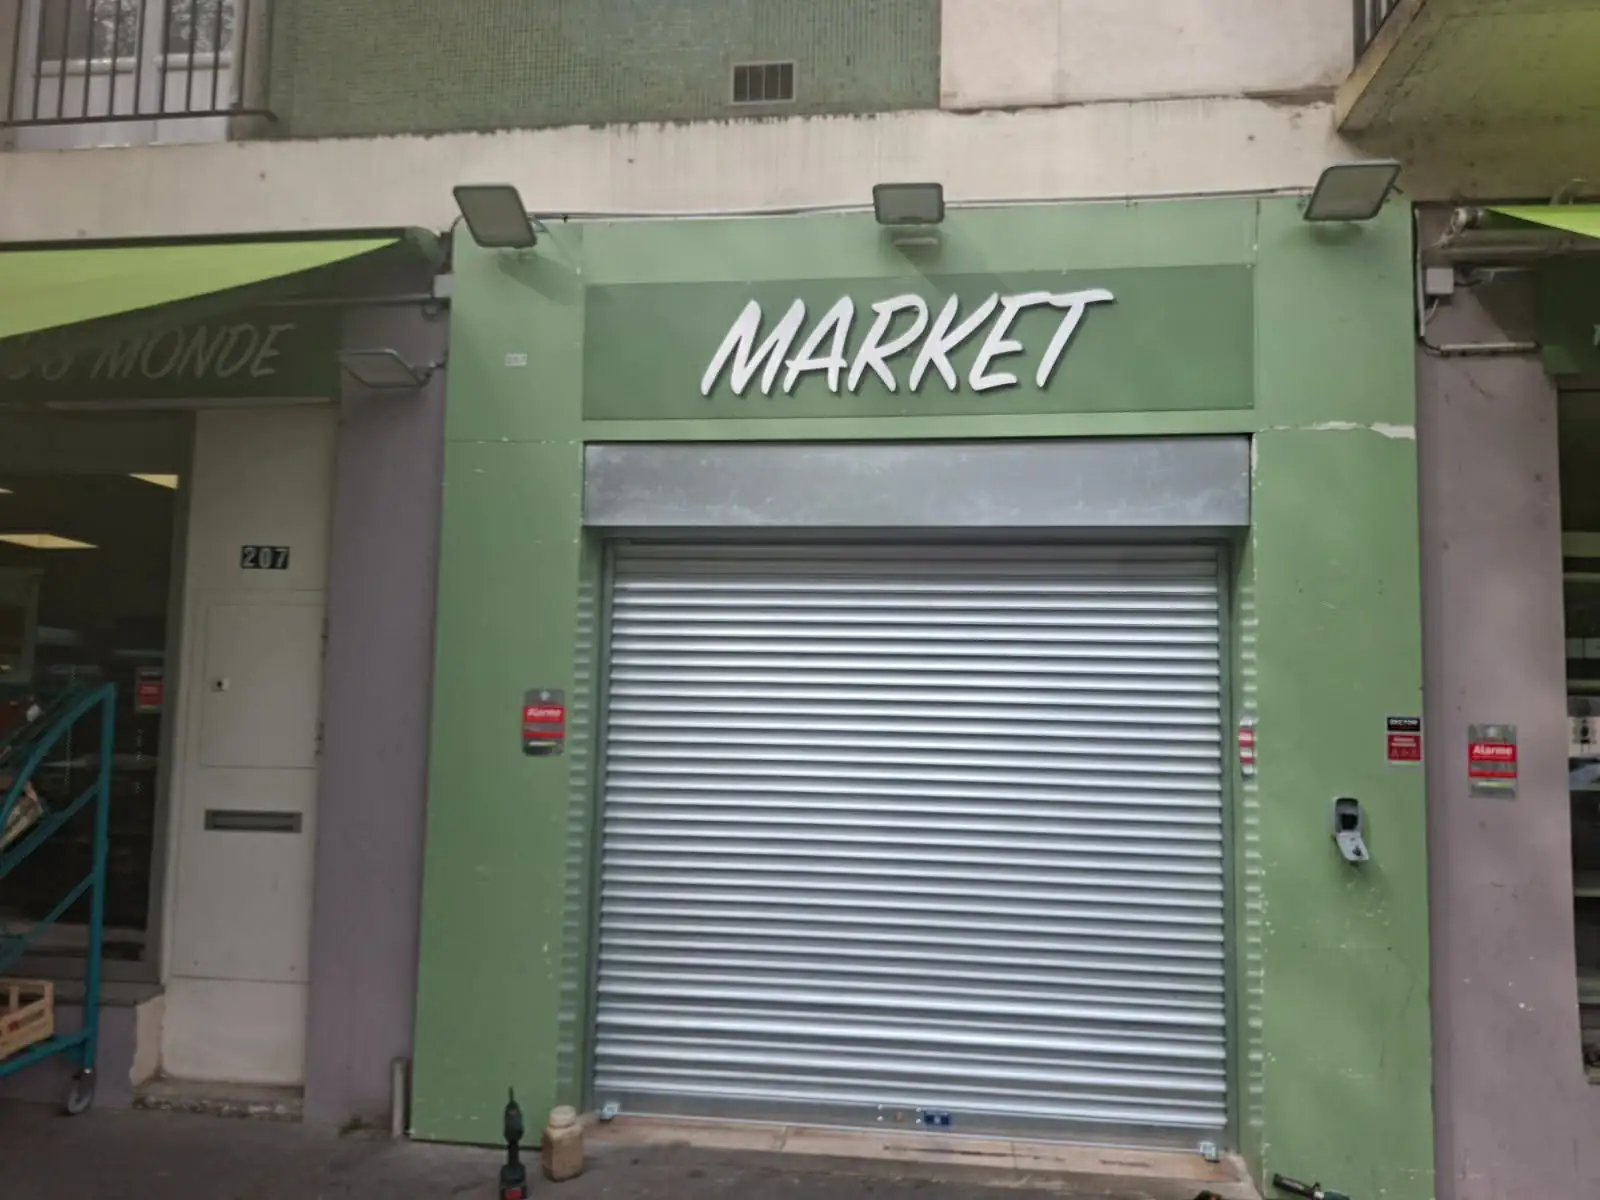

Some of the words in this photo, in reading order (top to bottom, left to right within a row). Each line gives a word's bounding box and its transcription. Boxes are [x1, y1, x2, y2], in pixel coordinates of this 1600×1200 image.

[89, 322, 297, 380] MONDE
[701, 288, 1114, 396] MARKET
[242, 547, 289, 569] 207
[1472, 744, 1513, 756] Alarme
